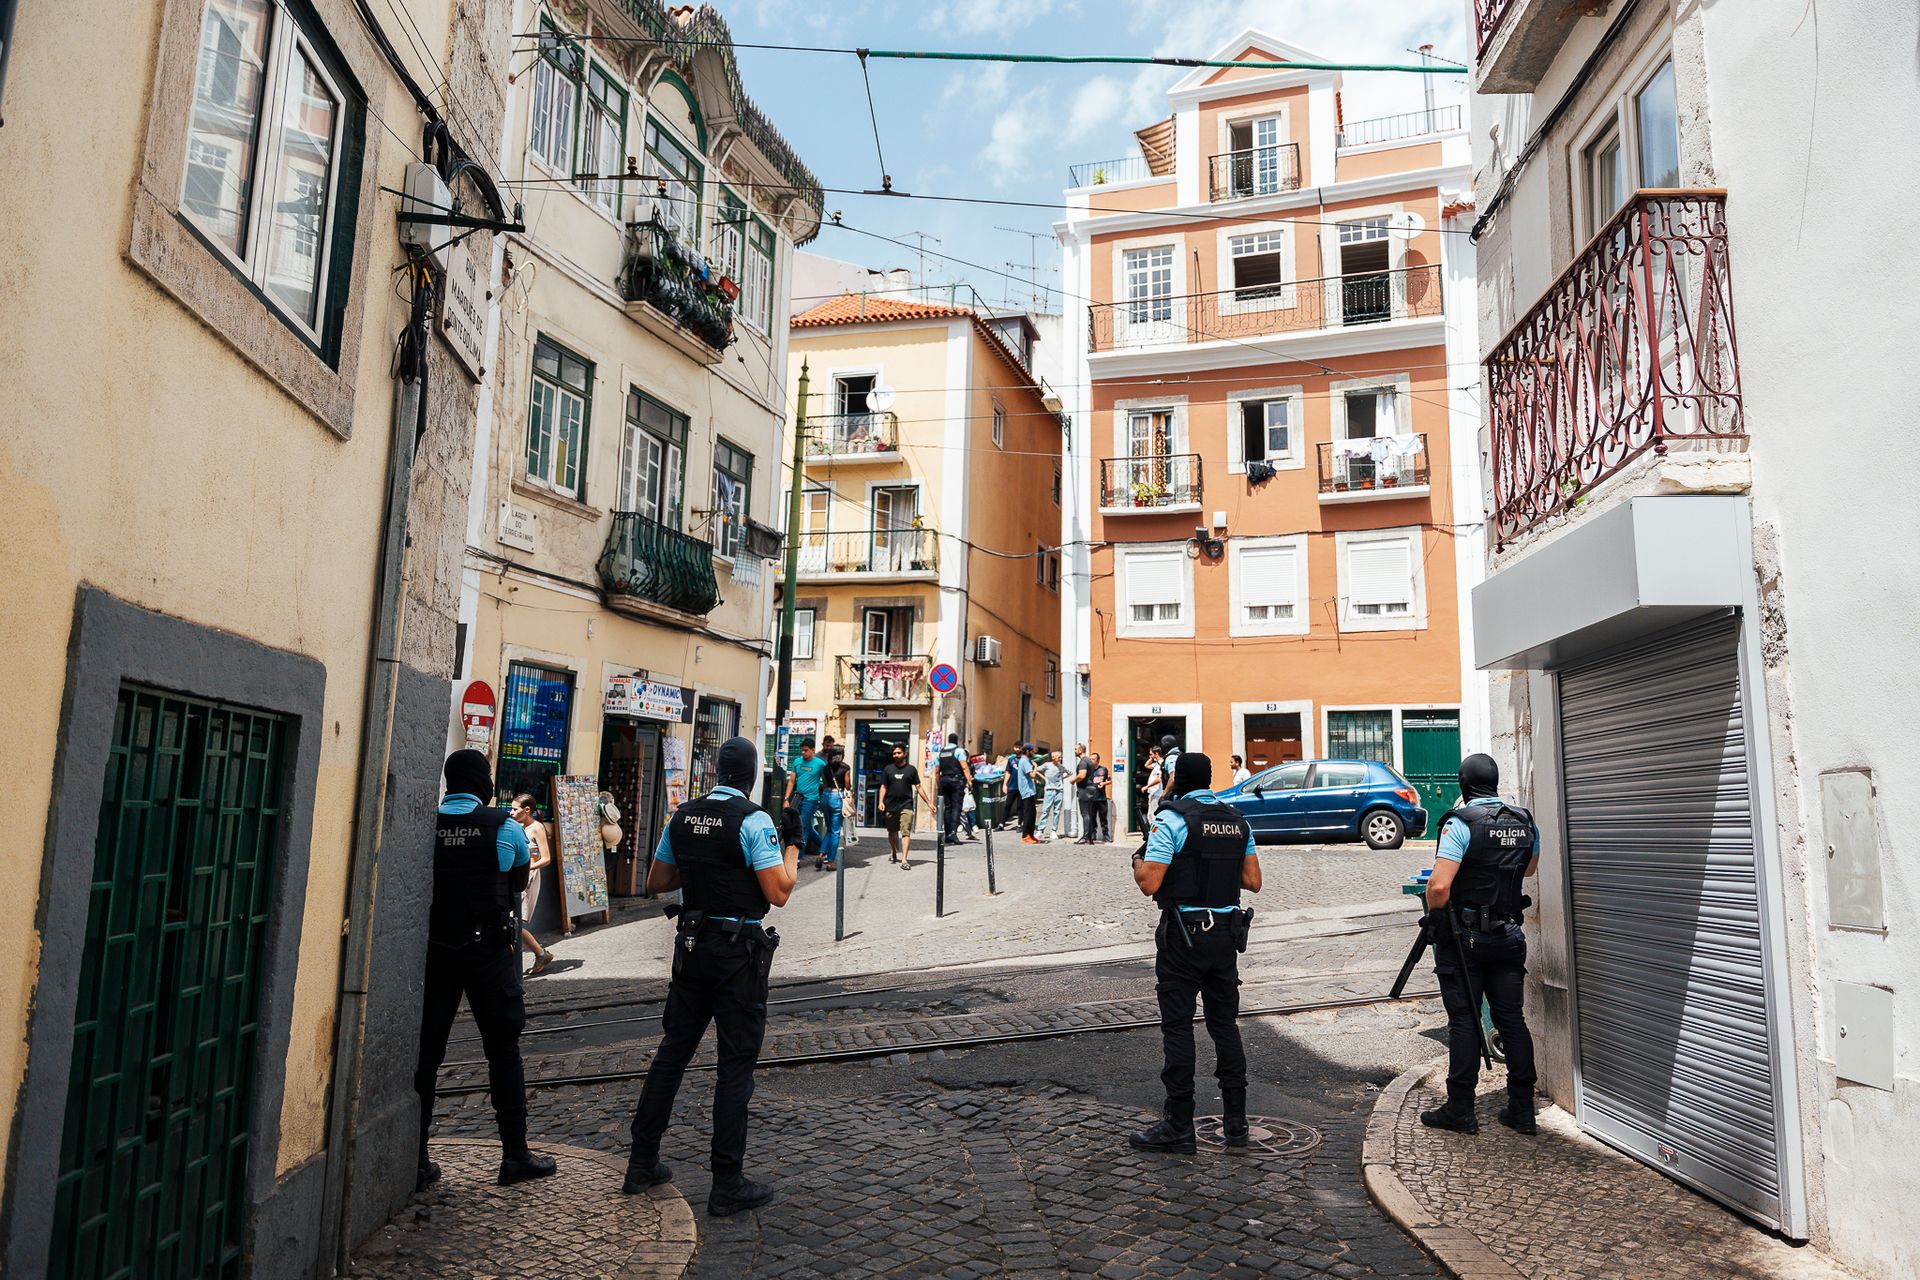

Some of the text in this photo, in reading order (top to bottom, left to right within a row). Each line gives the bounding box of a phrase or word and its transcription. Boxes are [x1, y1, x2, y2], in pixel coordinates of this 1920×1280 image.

[465, 257, 476, 286] RUA
[511, 509, 528, 522] LARGO
[652, 684, 681, 699] DYNAMIC
[684, 815, 723, 827] POLÍCIA
[436, 826, 481, 838] OLÍCIA
[693, 825, 710, 835] EIR
[1203, 823, 1241, 835] POLICIA
[1489, 827, 1527, 838] POLÍCIA
[444, 837, 466, 846] EIR
[1500, 837, 1517, 846] EIR
